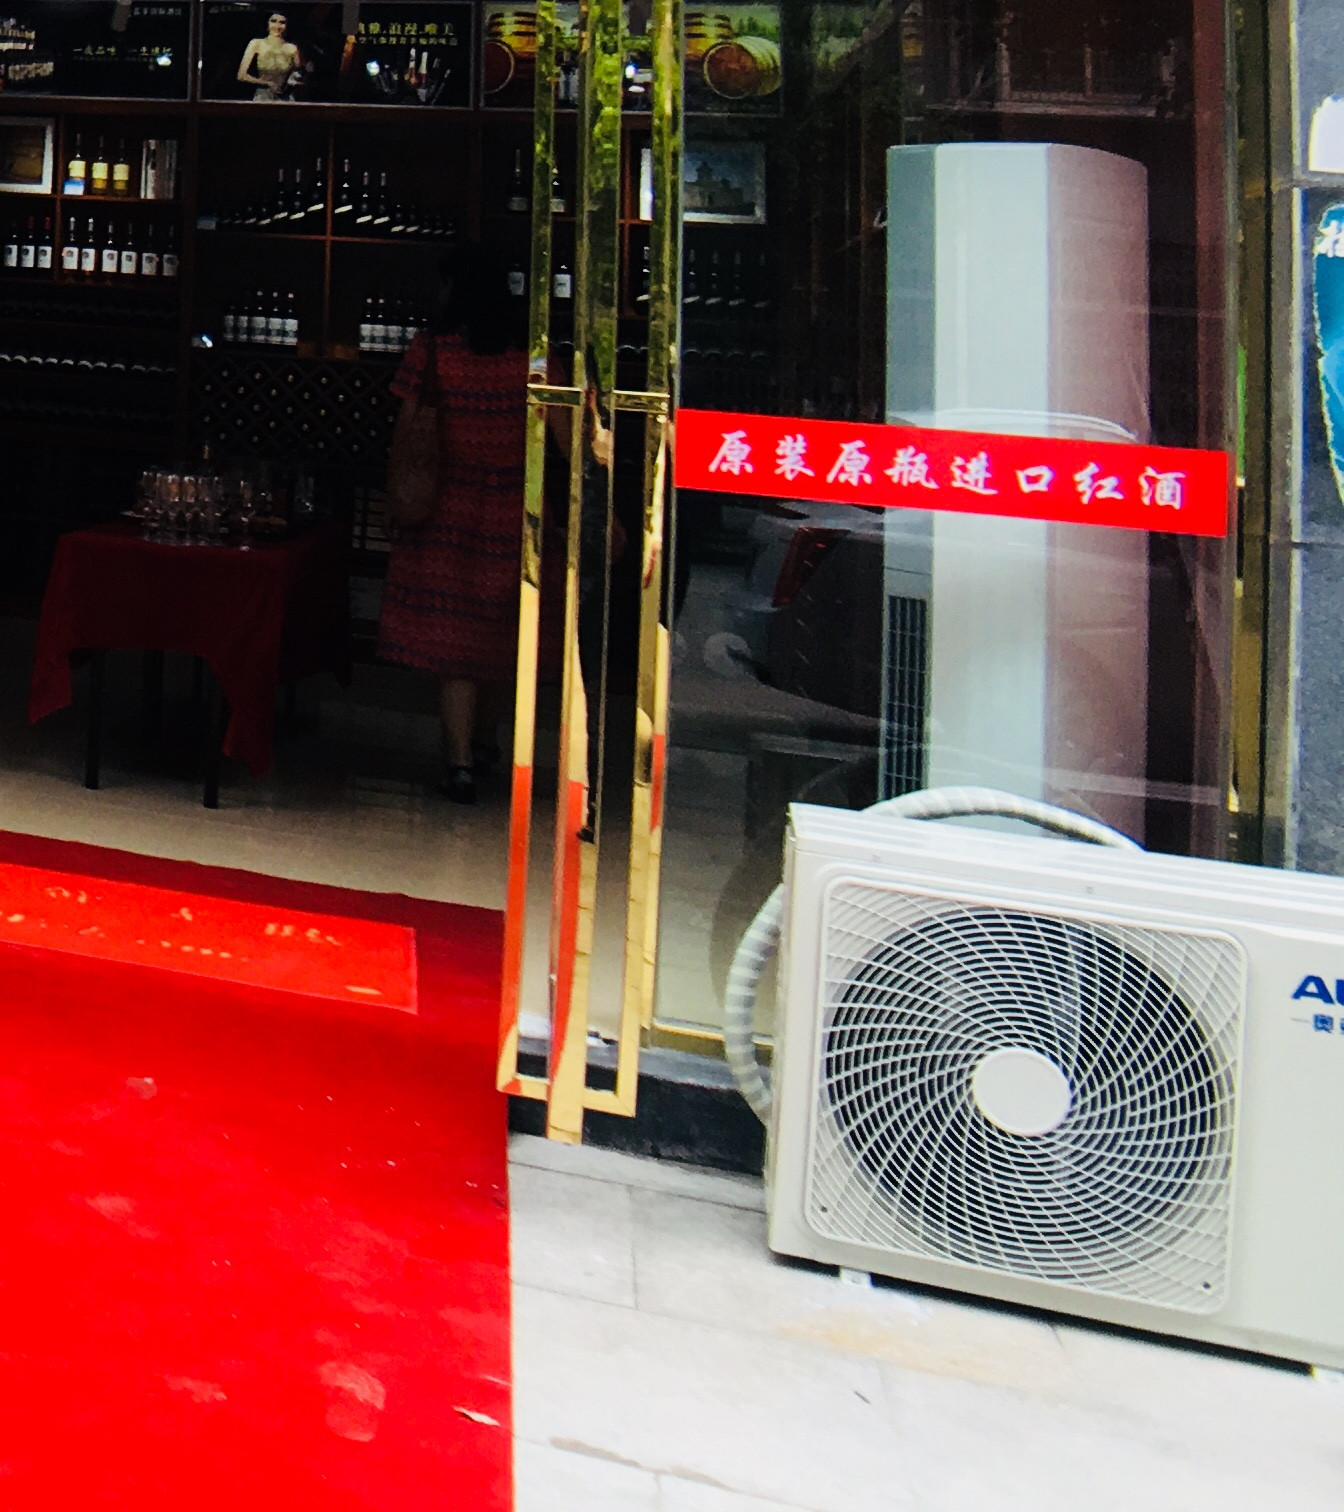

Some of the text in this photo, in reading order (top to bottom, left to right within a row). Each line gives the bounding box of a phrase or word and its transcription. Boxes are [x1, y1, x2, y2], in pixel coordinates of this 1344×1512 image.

[708, 430, 1187, 511] 原装原瓶进口红酒
